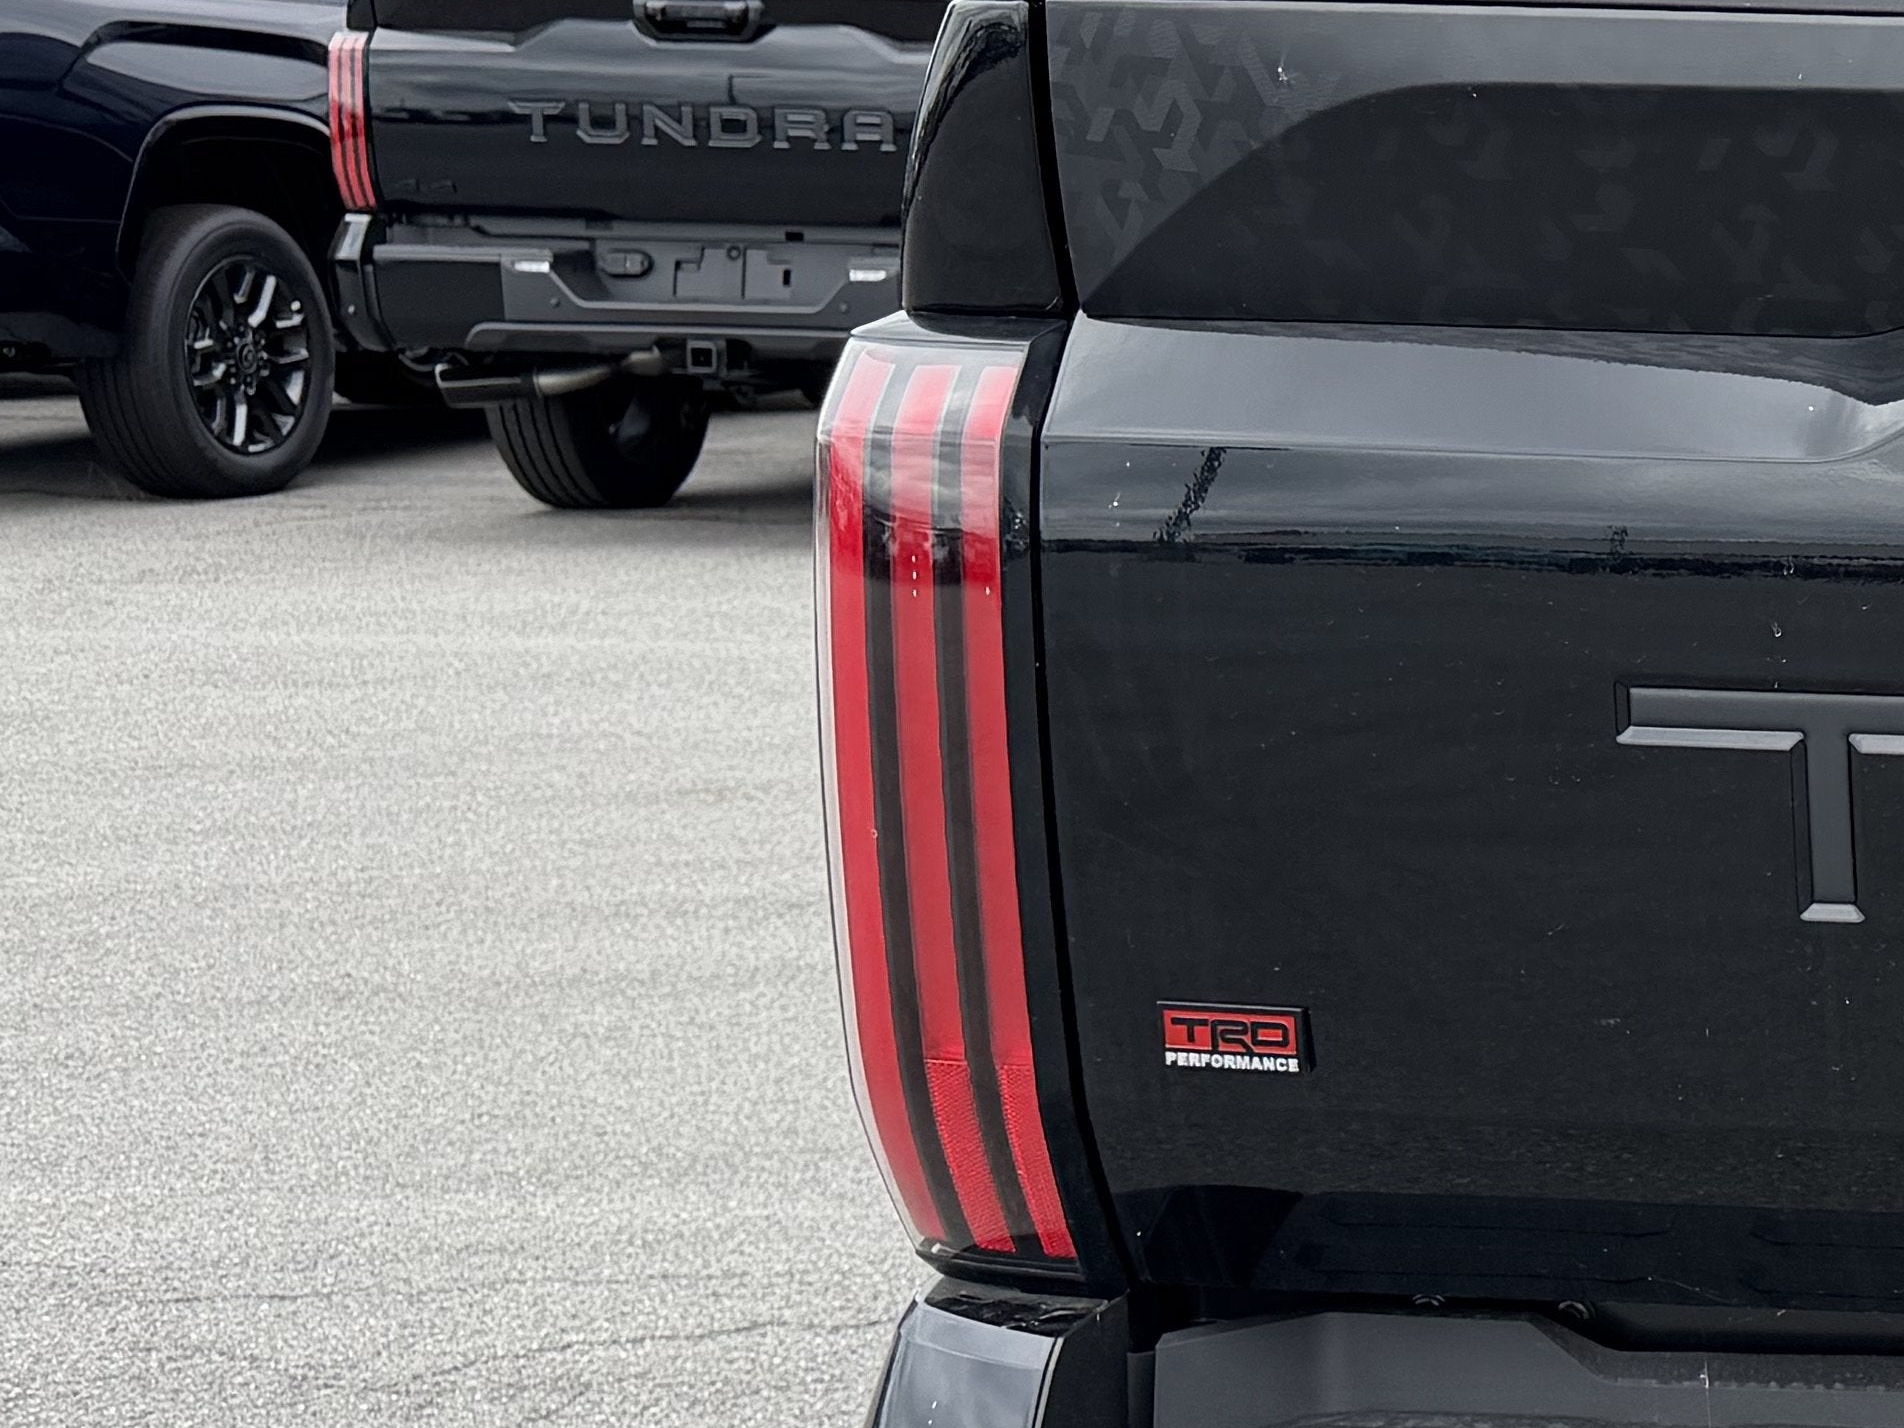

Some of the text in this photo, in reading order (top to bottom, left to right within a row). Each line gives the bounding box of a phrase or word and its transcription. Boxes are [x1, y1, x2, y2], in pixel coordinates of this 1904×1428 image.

[507, 101, 898, 152] TUNDRA
[1170, 1017, 1290, 1052] TRD
[1164, 1051, 1300, 1072] PERFORMANCE
